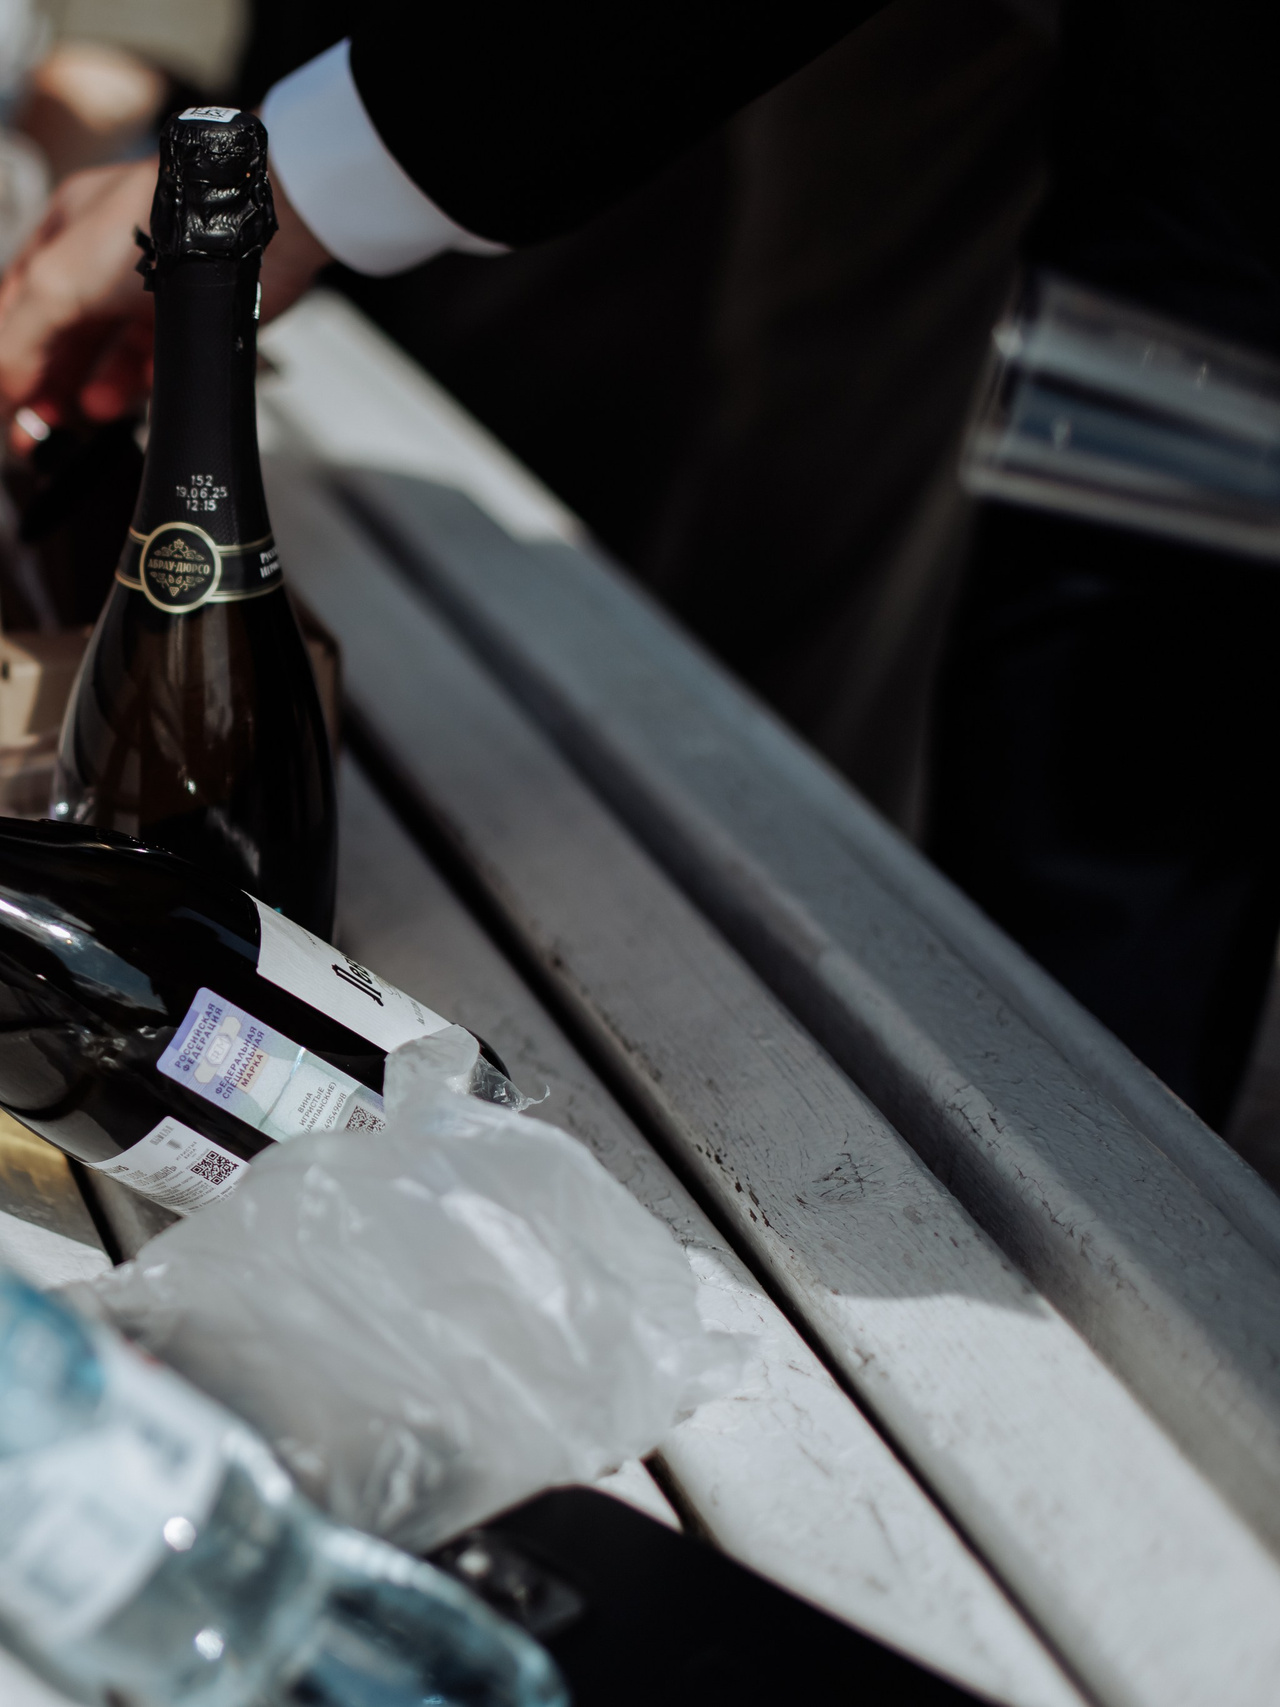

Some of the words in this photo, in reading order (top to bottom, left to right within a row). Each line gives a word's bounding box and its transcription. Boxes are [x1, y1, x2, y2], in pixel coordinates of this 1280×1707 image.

[176, 486, 228, 498] 19.06.25
[191, 475, 214, 486] 152
[186, 499, 217, 511] 12:15
[174, 1002, 216, 1068] РОССИЙСКАЯ
[183, 1007, 223, 1071] ФЕДЕРАЦИЯ
[215, 1026, 258, 1094] ФЕДЕРАЛЬНАЯ
[221, 1030, 265, 1098] СПЕЦИАЛЬНАЯ
[241, 1054, 264, 1087] МАРКА
[297, 1092, 313, 1113] ВИНА
[299, 1086, 324, 1126] ИГРИСТЫЕ
[303, 1081, 337, 1134] ШАМПАНСКИЕ)
